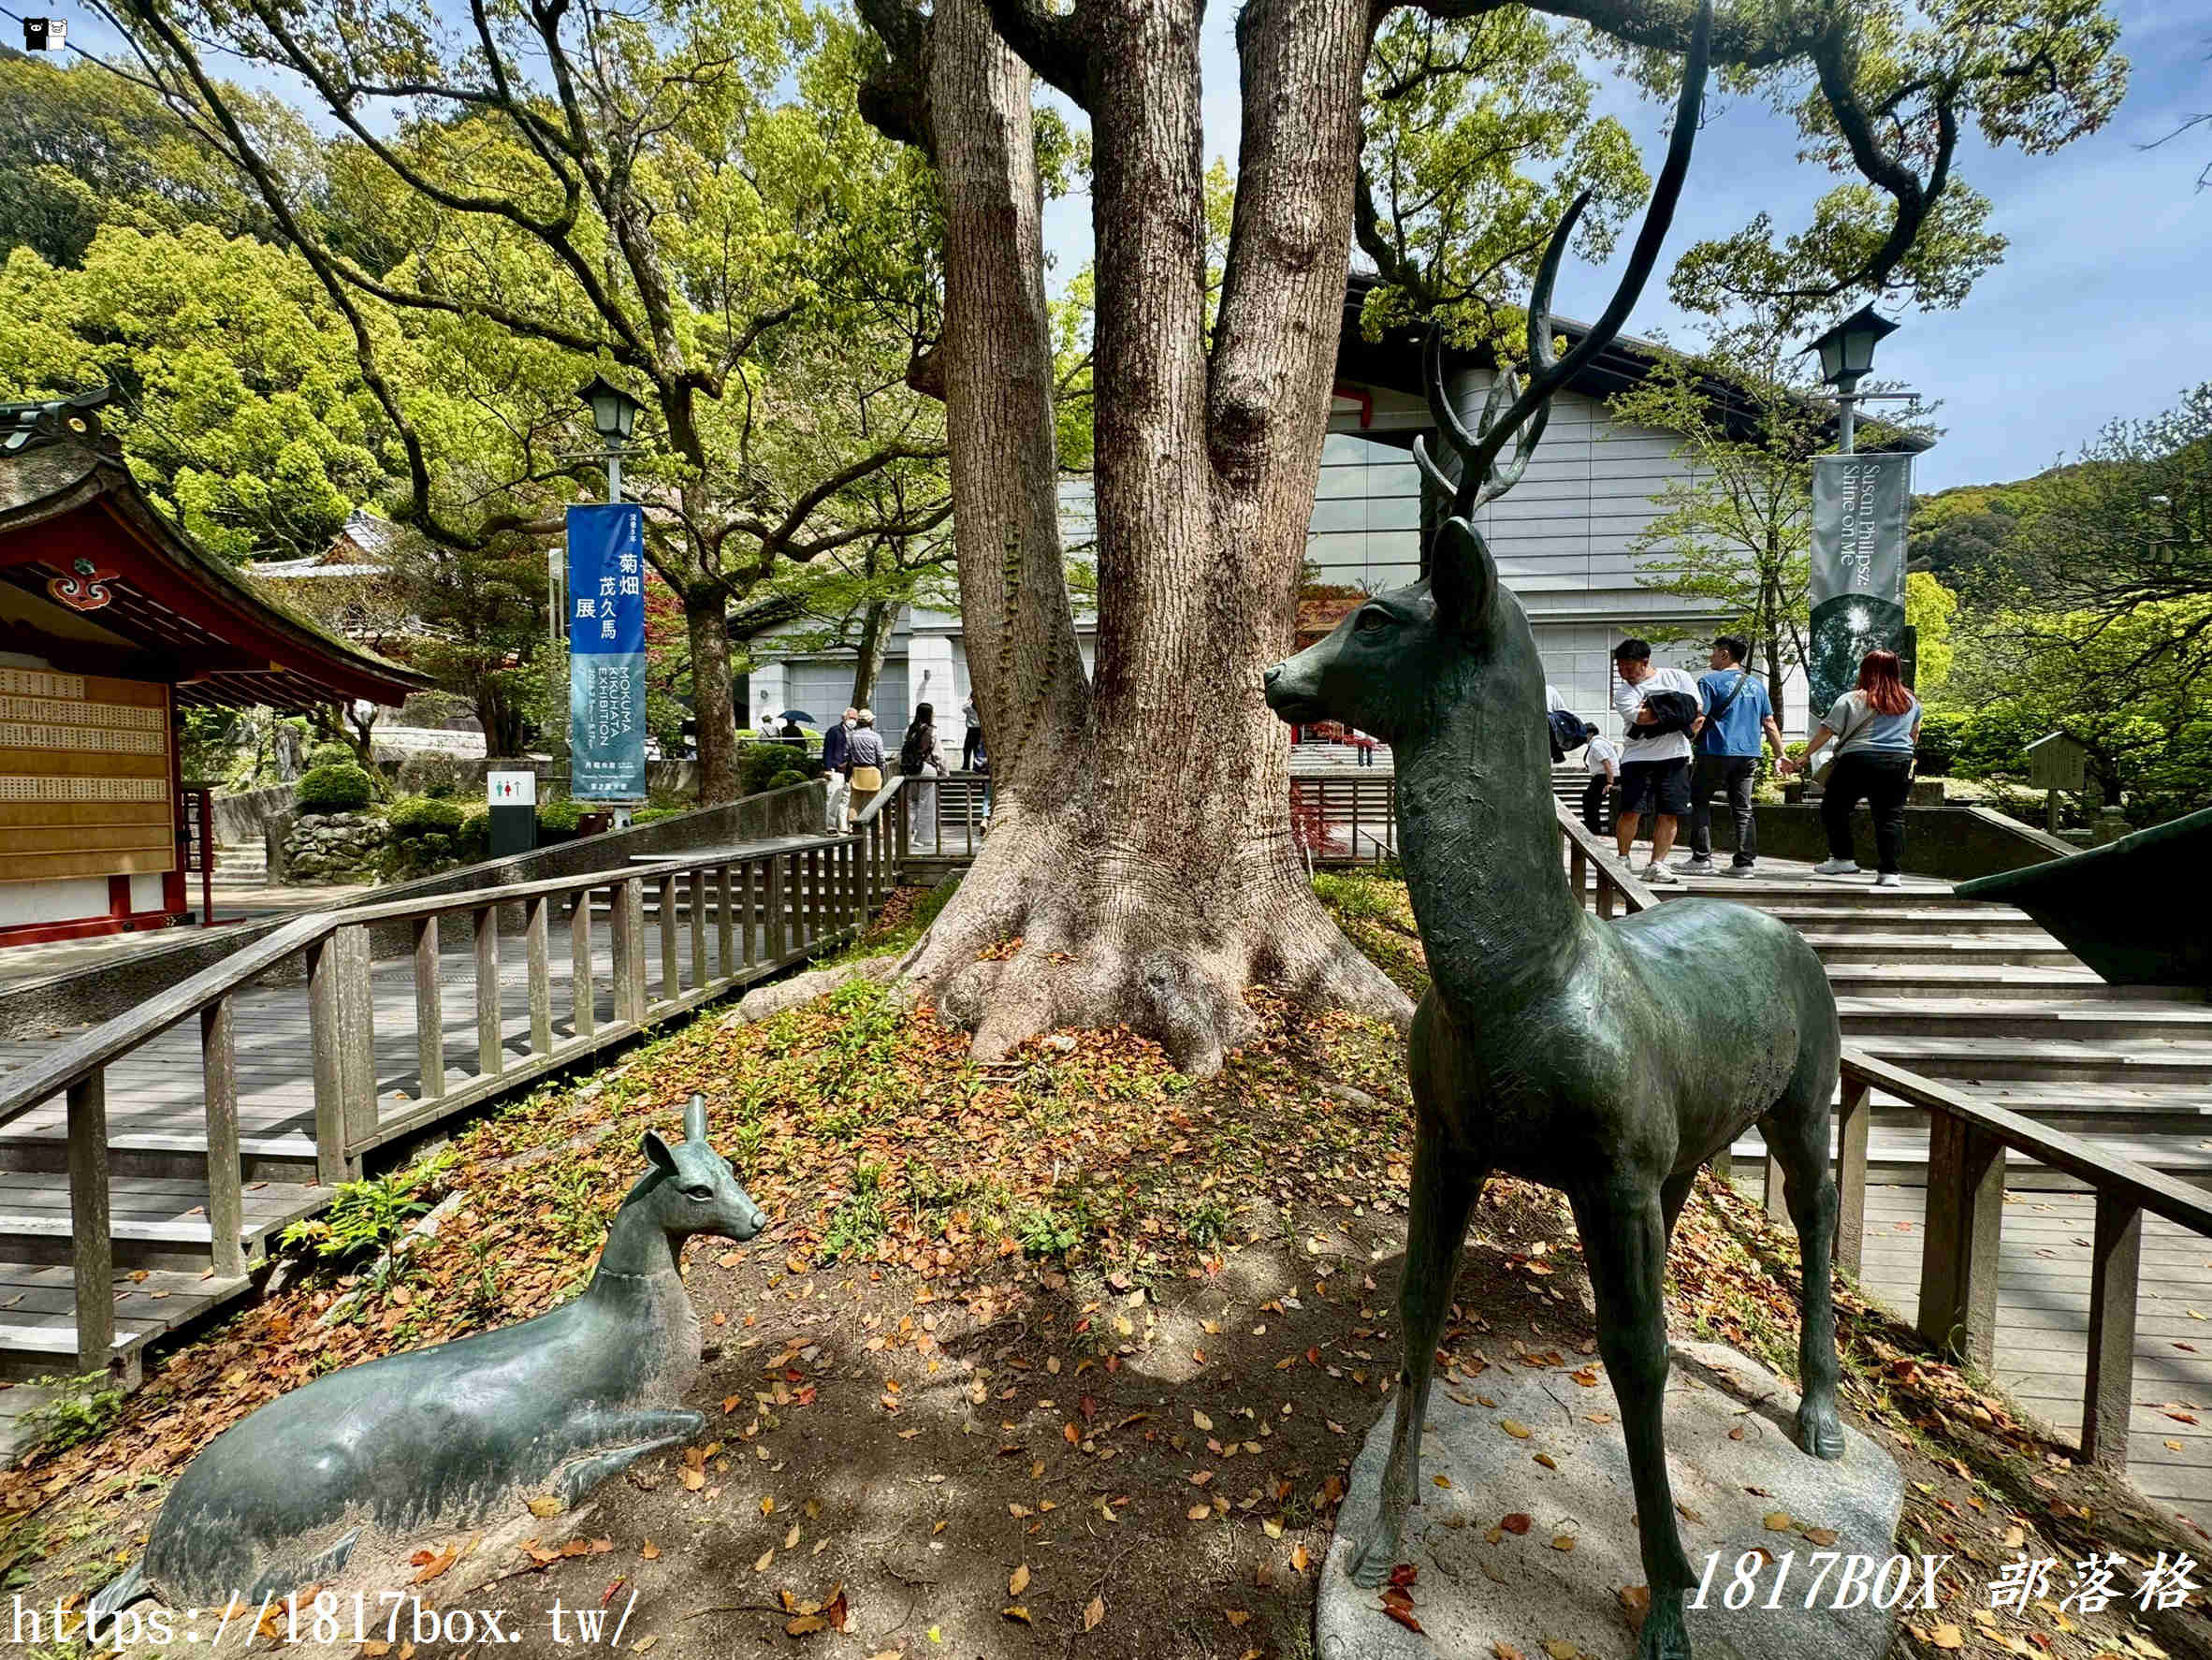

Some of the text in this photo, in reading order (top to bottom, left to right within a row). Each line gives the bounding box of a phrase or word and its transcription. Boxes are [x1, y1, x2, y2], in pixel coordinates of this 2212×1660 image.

[1841, 464, 1860, 566] Shine on Me
[1856, 464, 1881, 586] Susan Philipsz:
[599, 576, 617, 639] 茂久馬
[618, 553, 639, 595] 菊畑
[575, 599, 596, 619] 展
[598, 666, 609, 746] EXHIBITION
[608, 666, 619, 737] KIKUHATA
[619, 666, 632, 734] MOKUMA
